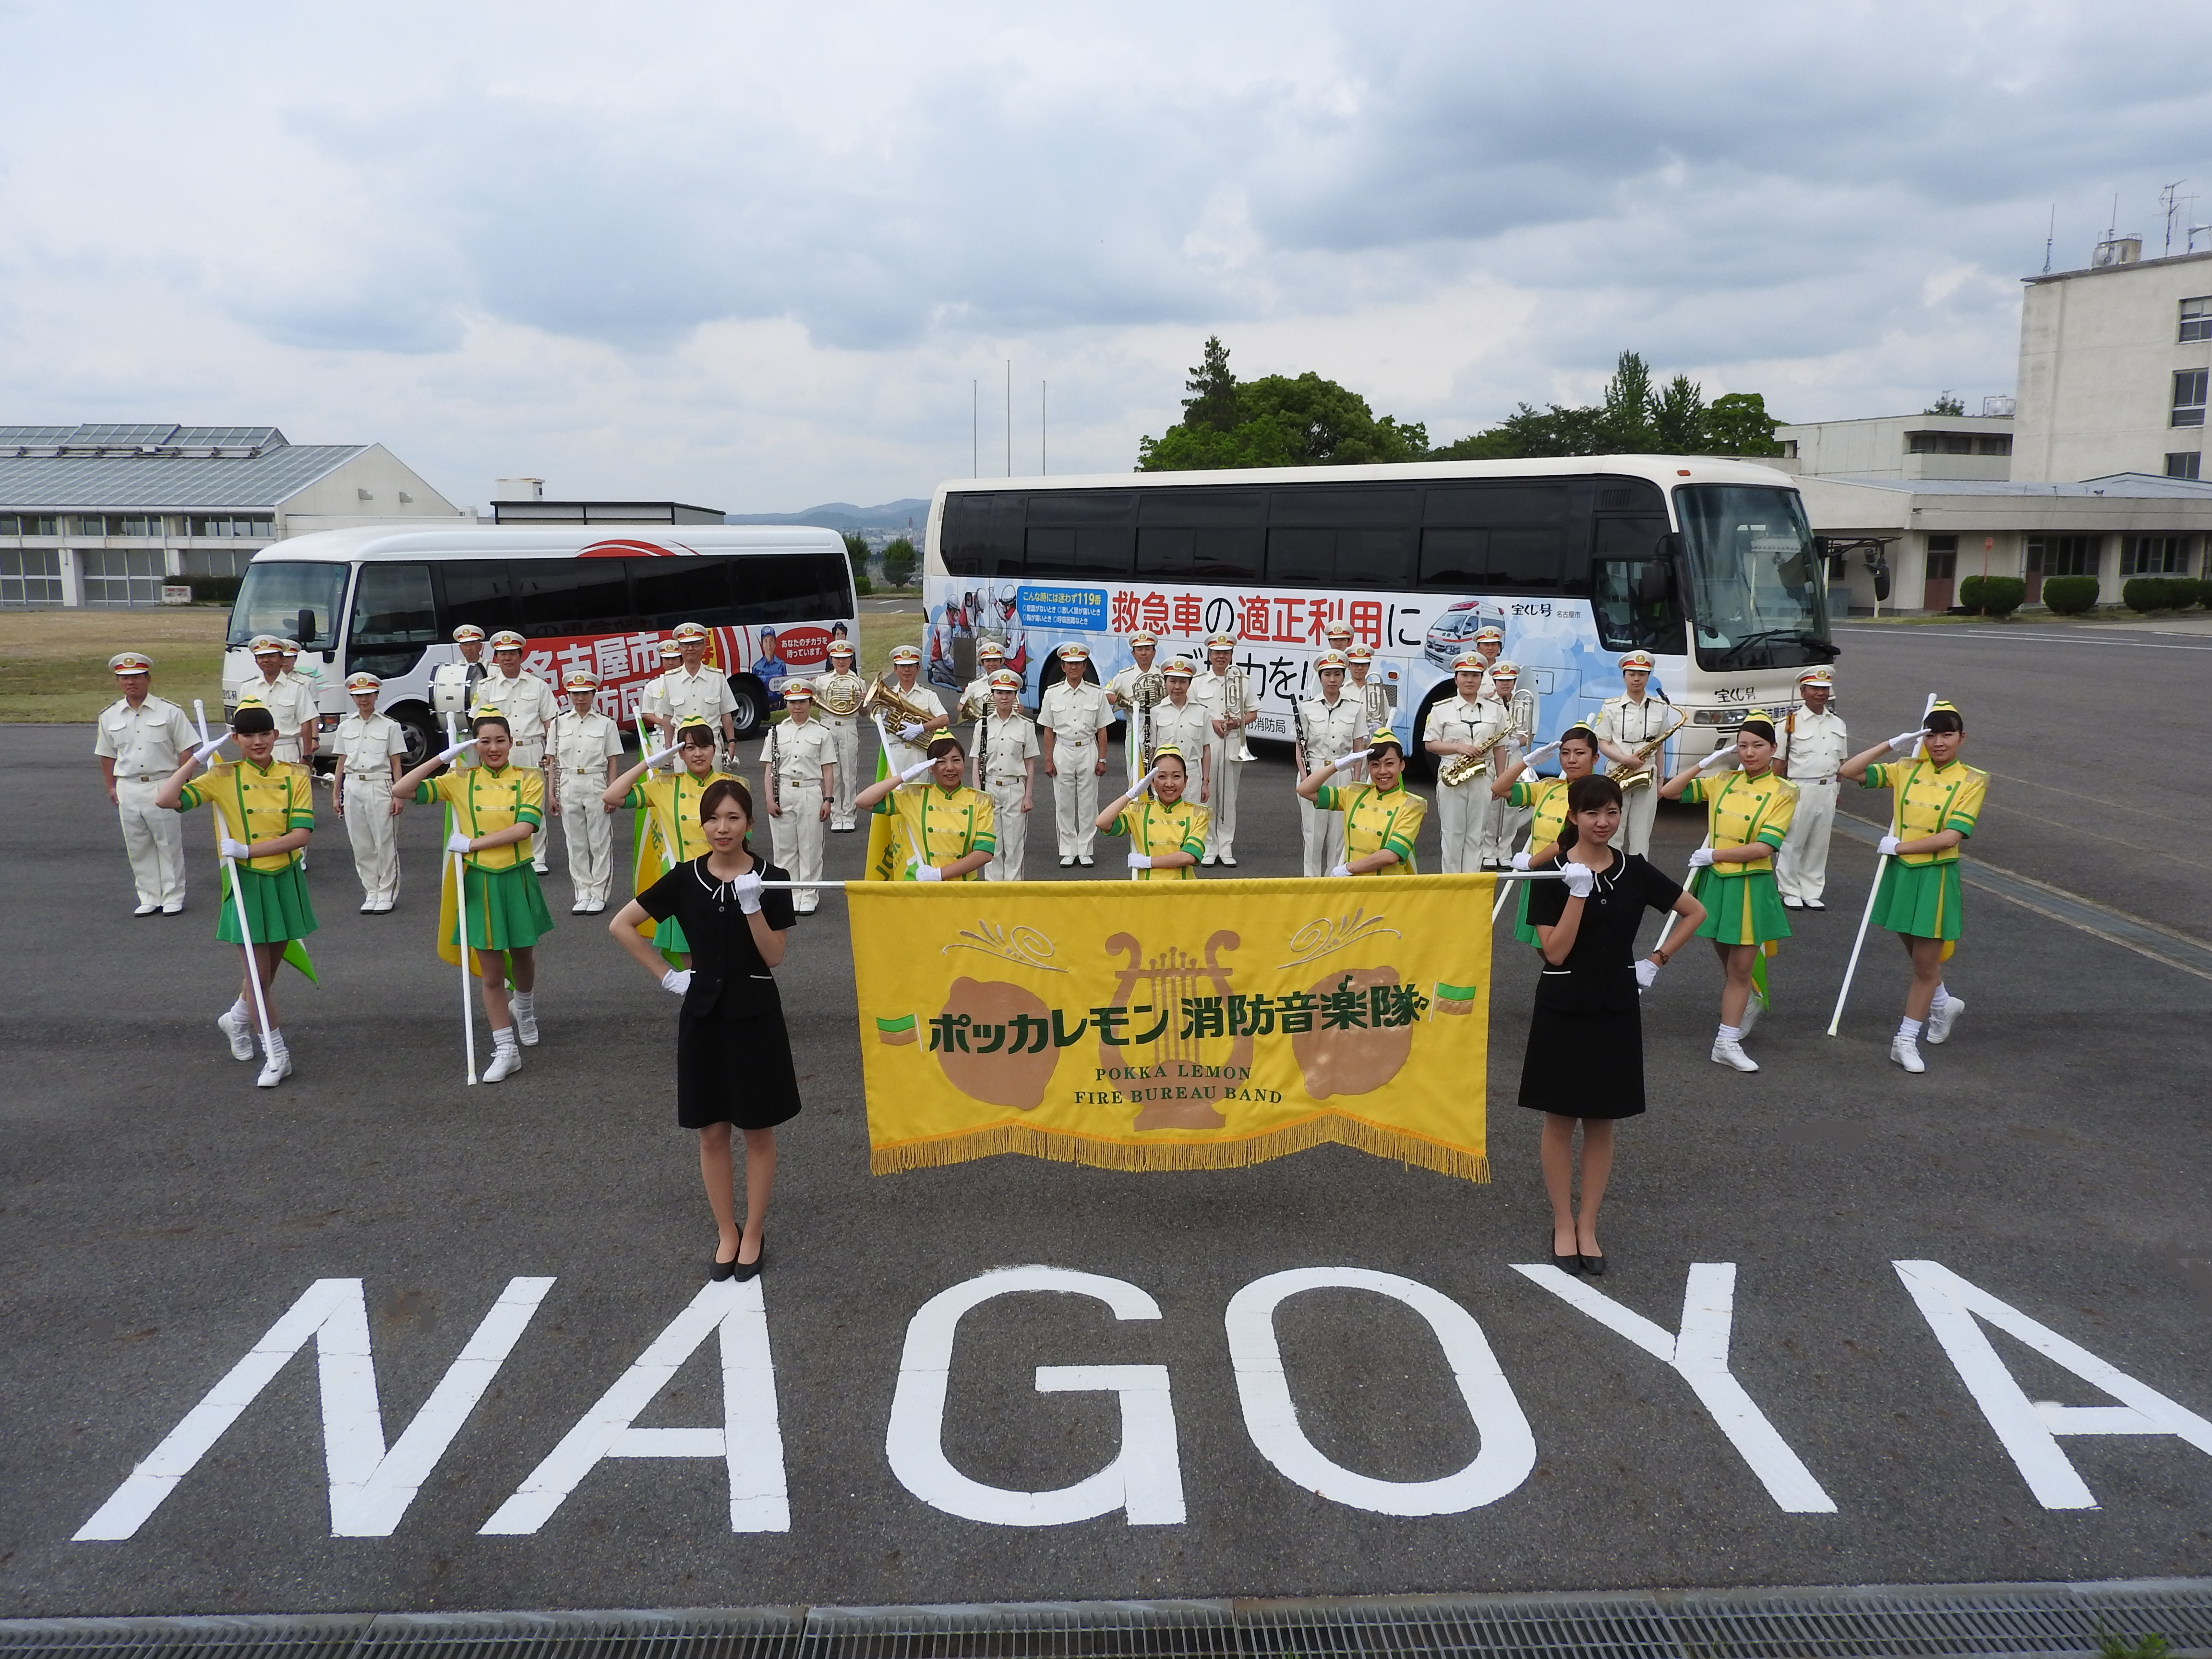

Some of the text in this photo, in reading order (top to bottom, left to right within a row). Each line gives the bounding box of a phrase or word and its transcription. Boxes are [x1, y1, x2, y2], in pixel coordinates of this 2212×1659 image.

[1511, 603, 1552, 617] 宝くじ号
[1556, 610, 1581, 619] 名古屋市
[1111, 590, 1421, 649] 救急車の適正利用に
[781, 637, 828, 648] あなたのチカラを
[521, 632, 661, 691] 名古屋市
[786, 647, 823, 659] 待っています。
[1714, 686, 1756, 703] 宝くじ号
[929, 982, 1420, 1055] ポッカレモン 消防音楽隊
[1095, 1064, 1251, 1081] POKKA LEMON
[1074, 1086, 1282, 1105] FIRE BUREAU BAND
[71, 1260, 2212, 1542] NAGOYA
